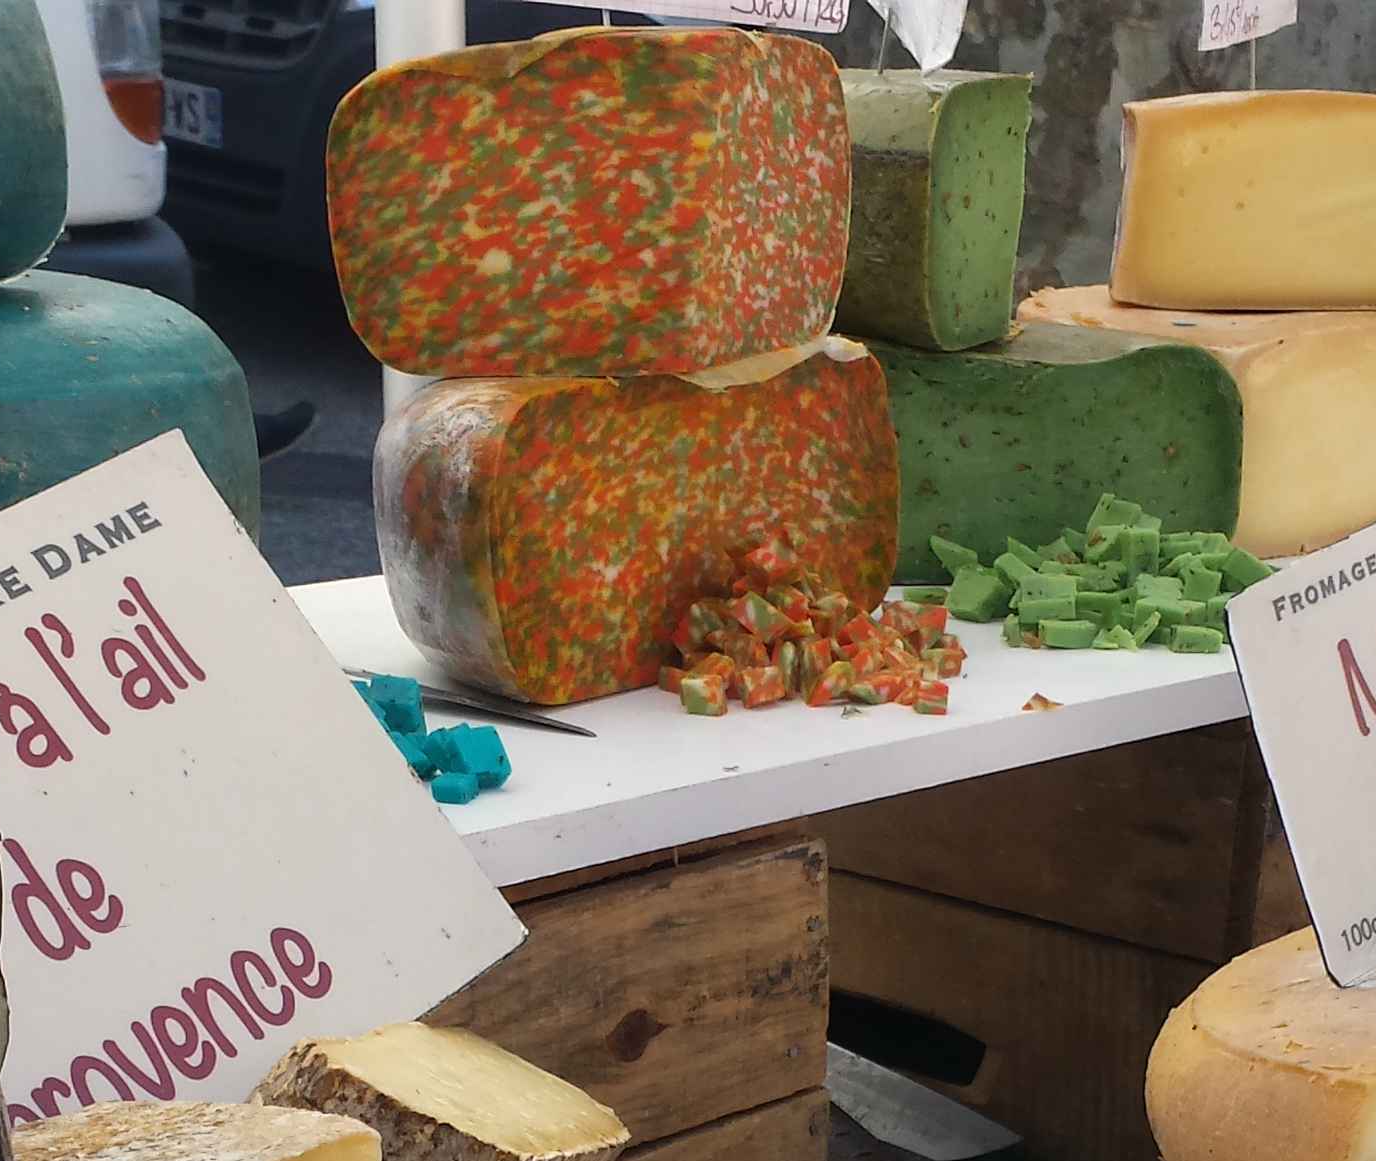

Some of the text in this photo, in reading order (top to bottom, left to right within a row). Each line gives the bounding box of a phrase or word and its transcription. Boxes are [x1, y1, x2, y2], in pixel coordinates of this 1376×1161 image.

[30, 501, 162, 580] DAME
[24, 576, 206, 735] l'ail
[2, 838, 123, 961] de
